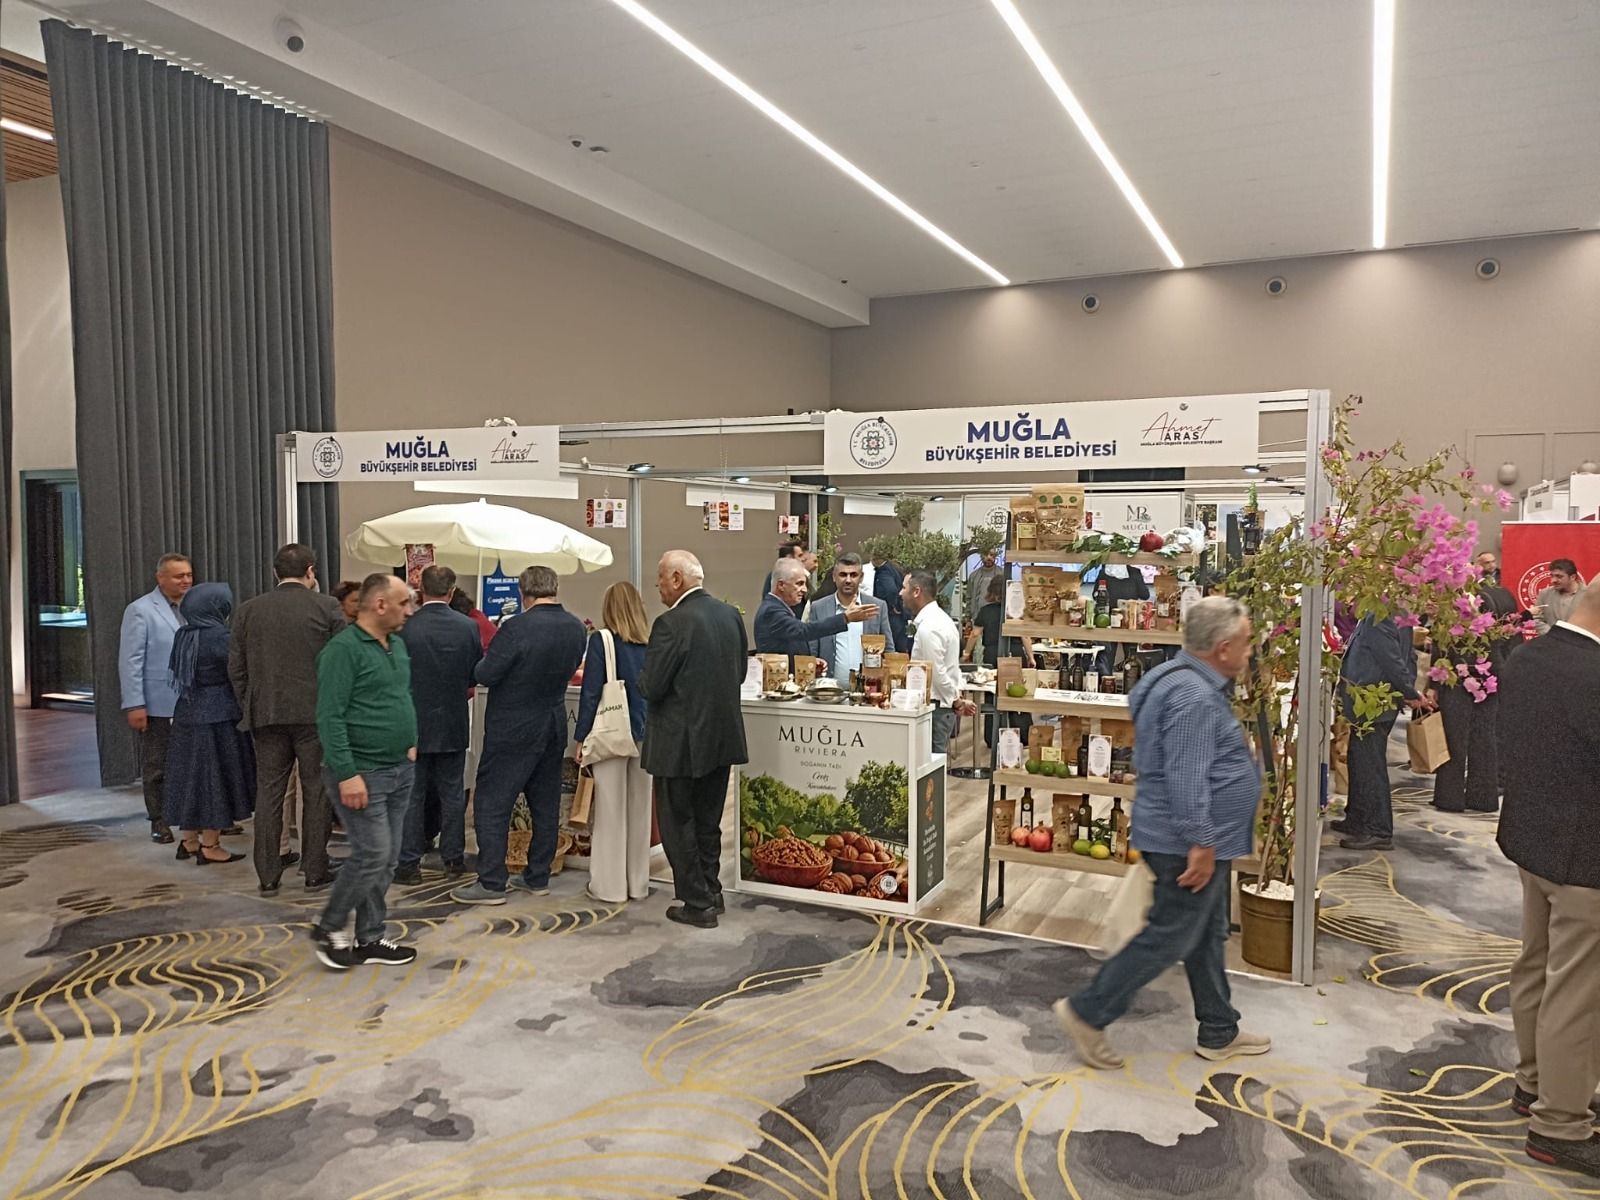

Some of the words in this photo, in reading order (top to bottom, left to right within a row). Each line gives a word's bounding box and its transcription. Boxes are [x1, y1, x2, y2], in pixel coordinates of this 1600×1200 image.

[968, 412, 1072, 443] MUĞLA
[1141, 411, 1223, 440] Ahmet
[1164, 431, 1199, 441] ARAS
[386, 435, 450, 459] MUĞLA
[926, 444, 1020, 464] BÜYÜKŞEHİR
[1024, 440, 1117, 459] BELEDİYESİ
[360, 460, 419, 475] BÜYÜKŞEHİR
[421, 458, 477, 472] BELEDİYESİ
[778, 725, 864, 748] MUĞLA
[795, 745, 847, 758] RIVIERA
